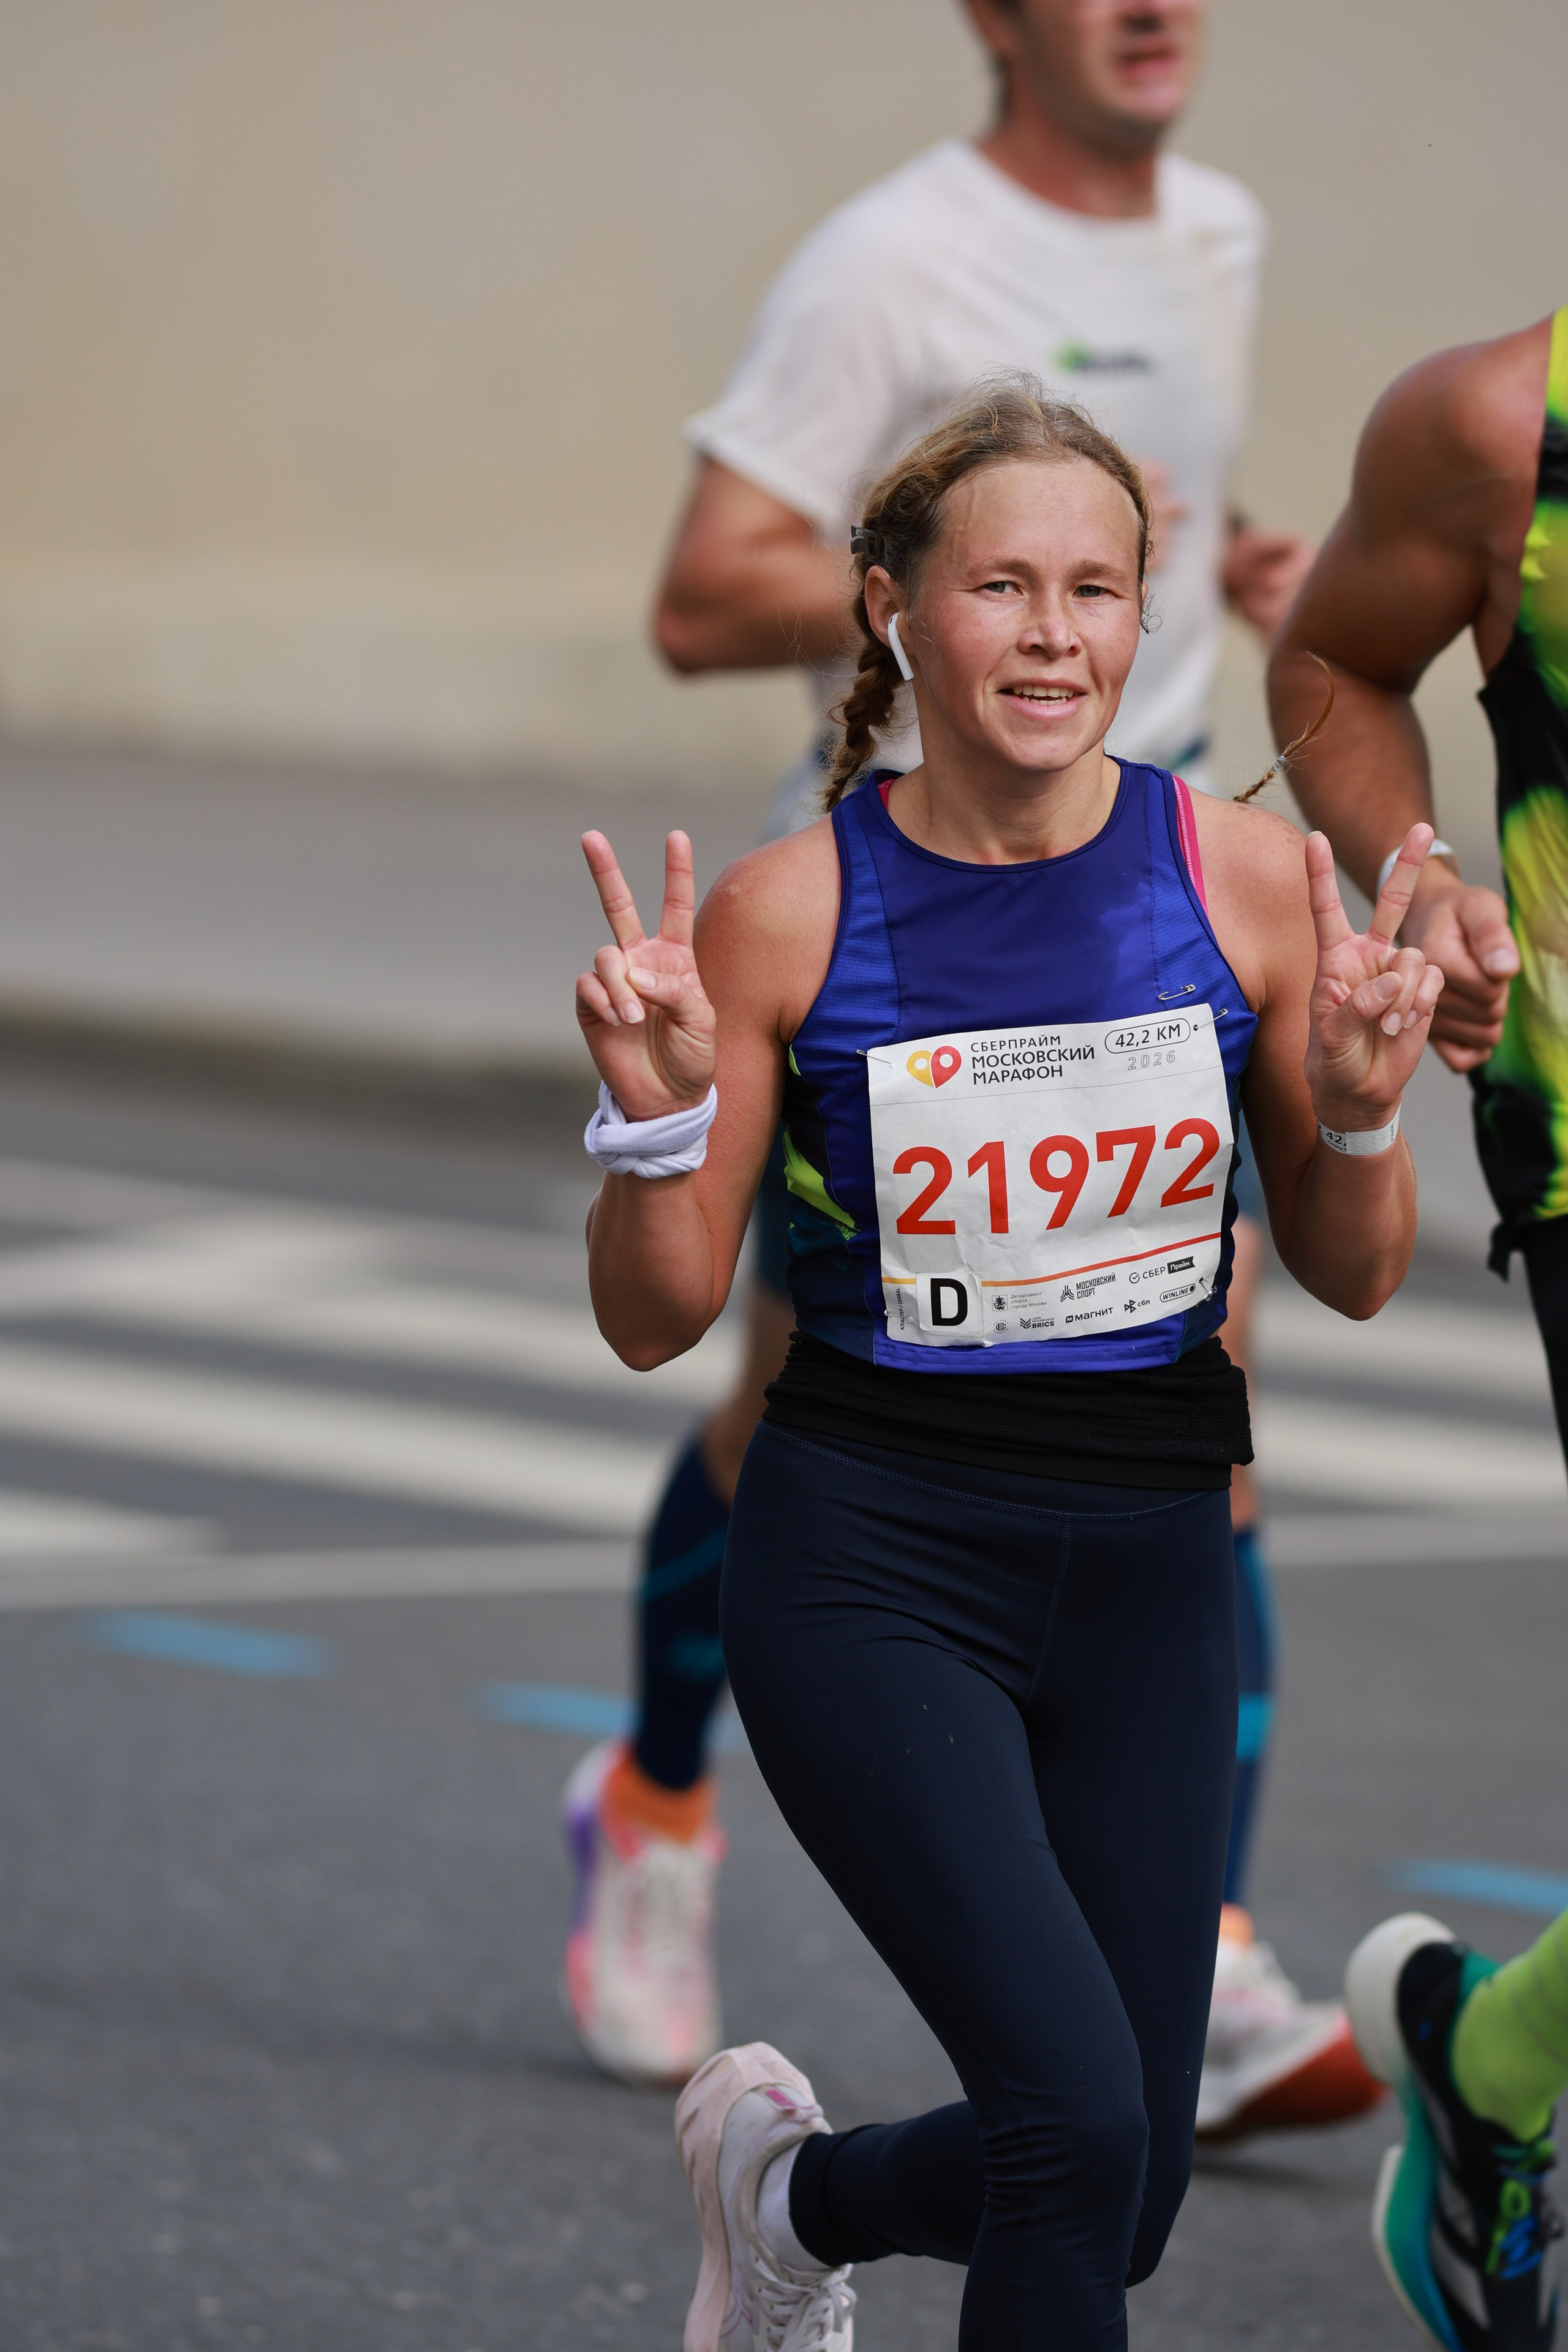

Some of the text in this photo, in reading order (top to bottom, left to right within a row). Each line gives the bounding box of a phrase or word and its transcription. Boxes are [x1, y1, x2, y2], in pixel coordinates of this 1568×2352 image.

[970, 1034, 1061, 1052] СБЕРПРАЙМ
[1115, 1023, 1180, 1048] 42,2 КМ
[971, 1044, 1095, 1069] МОСКОВСКИЙ
[1127, 1049, 1176, 1071] 2026
[973, 1064, 1063, 1085] МАРАФОН
[892, 1117, 1220, 1235] 21972
[1142, 1261, 1190, 1279] СБЕР Прайм
[1076, 1272, 1116, 1291] МОСКОВСКИЙ
[930, 1278, 968, 1327] D
[1077, 1287, 1095, 1299] СПОРТ
[1163, 1287, 1189, 1300] WINLINE
